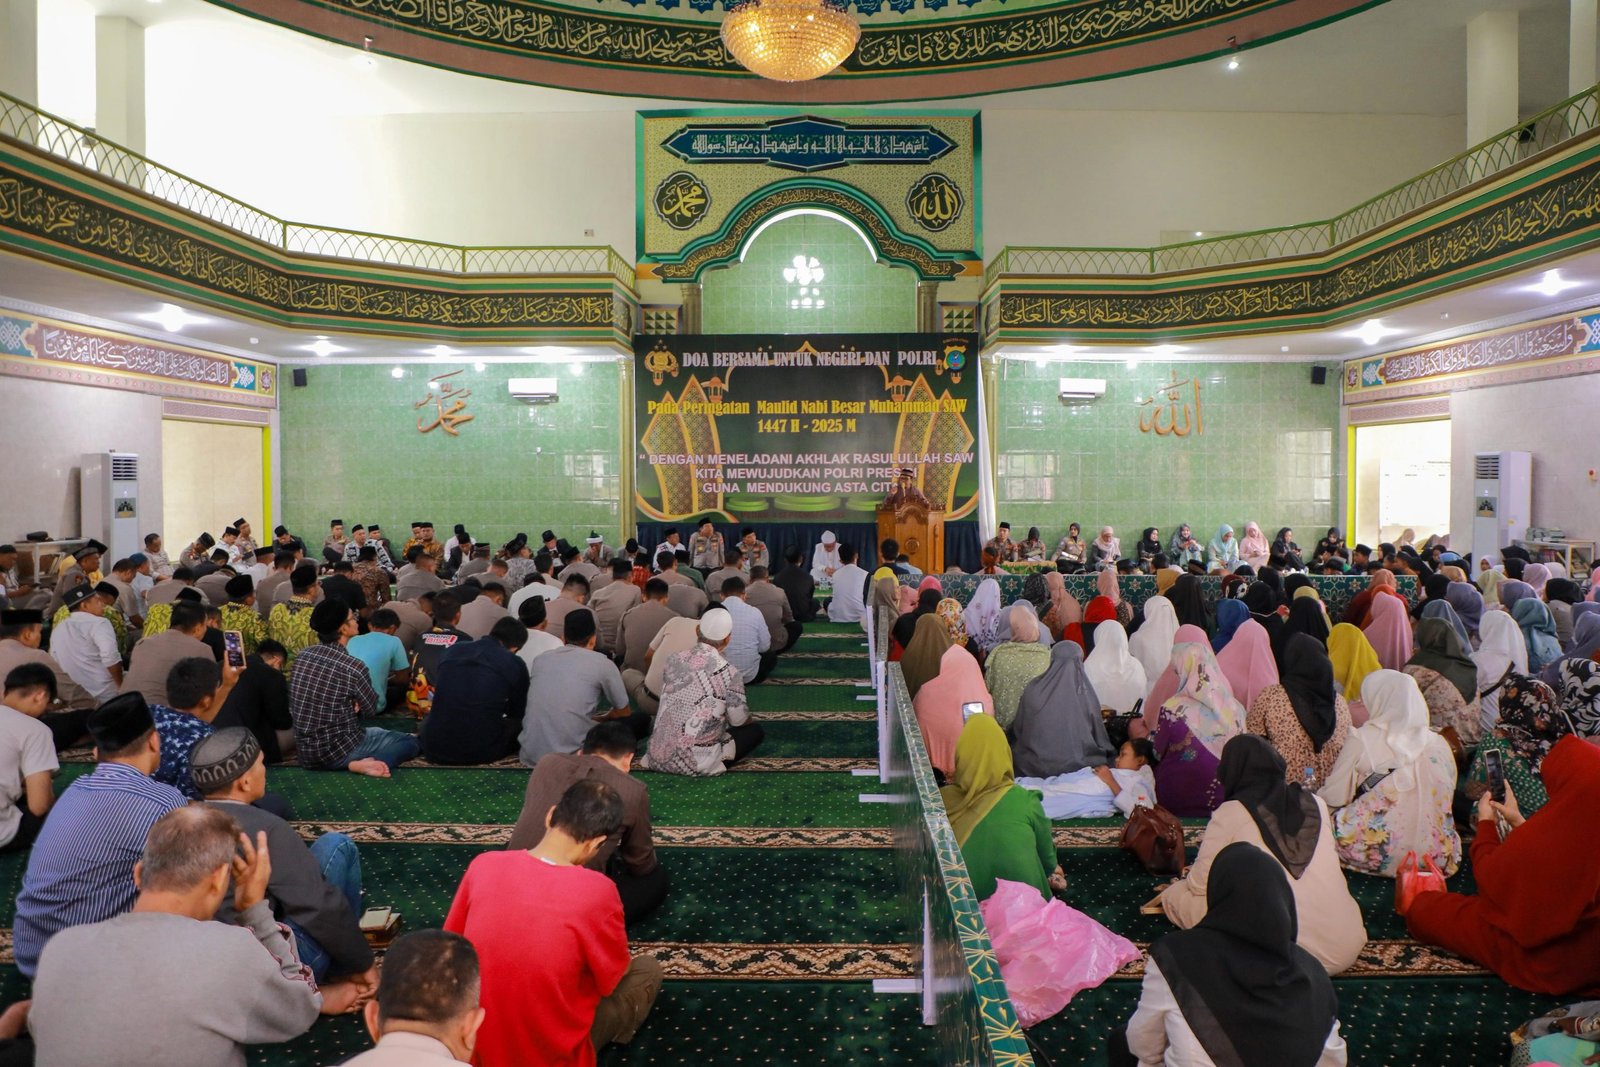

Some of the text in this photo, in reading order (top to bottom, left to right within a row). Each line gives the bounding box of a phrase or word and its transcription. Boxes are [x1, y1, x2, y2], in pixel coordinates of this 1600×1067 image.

[682, 350, 937, 367] DOA BERSAMA UNTUK NEGERI DAN POLRI
[647, 399, 968, 416] Pada Peringatan Maulid Nabi Besar Muhammad SAW
[757, 419, 788, 433] 1447
[790, 419, 801, 433] H
[811, 419, 843, 433] 2025
[846, 419, 857, 433] M
[649, 454, 704, 465] DENGAN
[707, 453, 793, 465] MENELADANI
[795, 453, 850, 465] AKHLAK
[853, 453, 941, 465] RASULULLAH
[944, 452, 974, 464] SAW
[695, 467, 918, 479] KITA MEWUJUDKAN POLRI PRESI
[702, 482, 741, 494] GUNA
[746, 482, 831, 493] MENDUKUNG
[833, 482, 869, 493] ASTA
